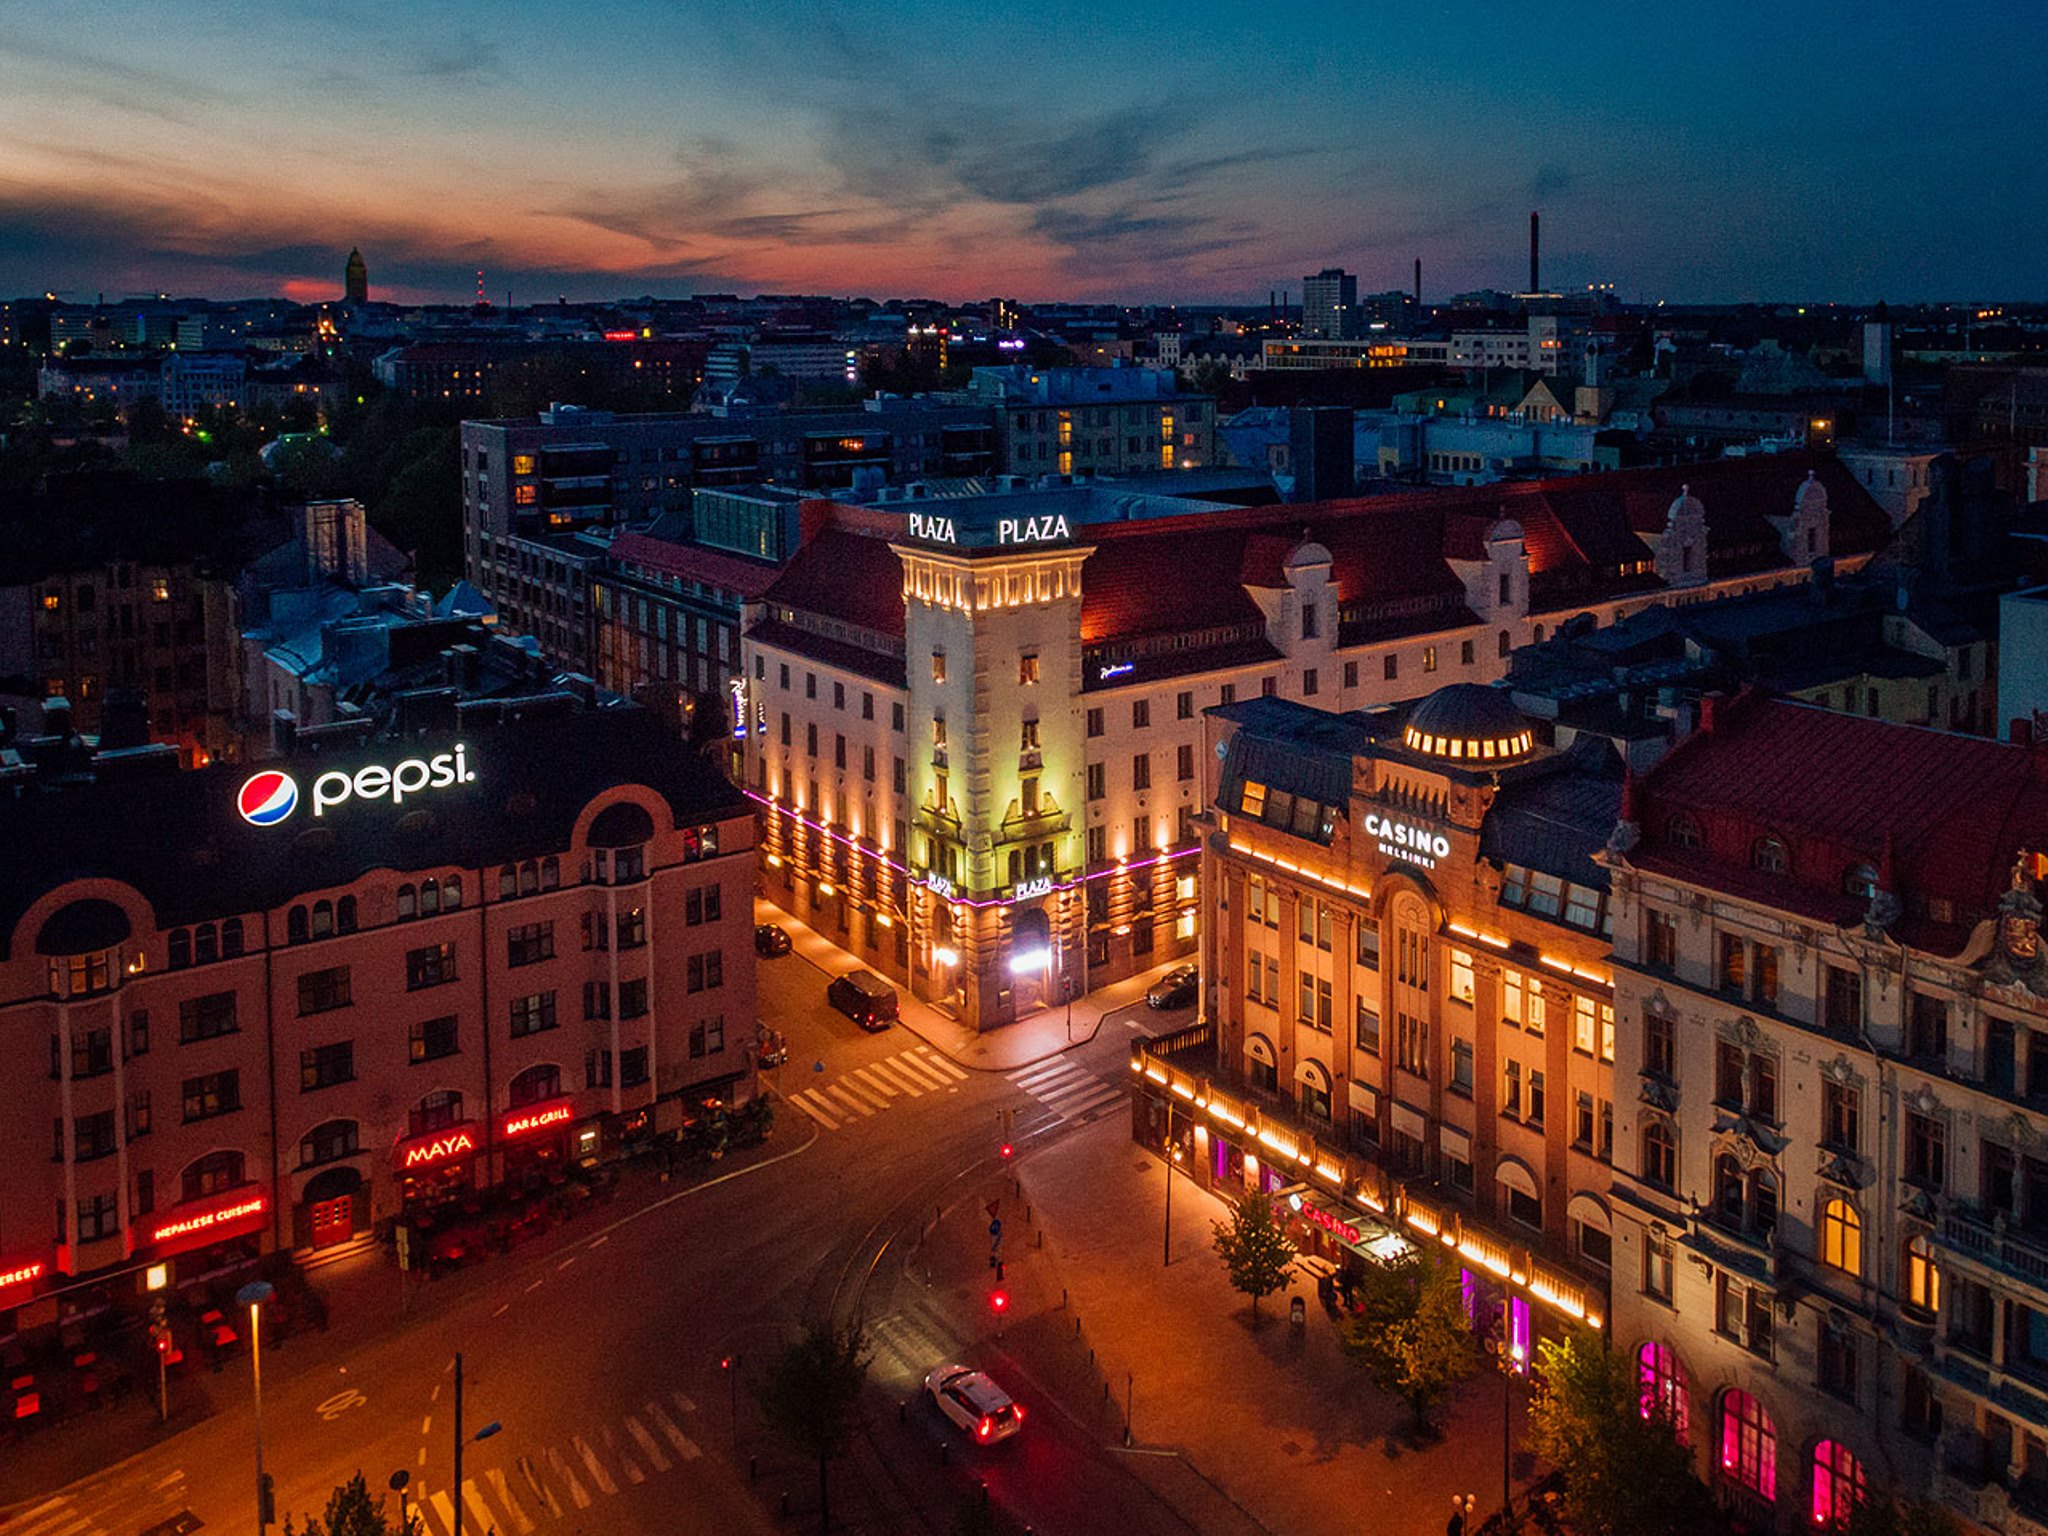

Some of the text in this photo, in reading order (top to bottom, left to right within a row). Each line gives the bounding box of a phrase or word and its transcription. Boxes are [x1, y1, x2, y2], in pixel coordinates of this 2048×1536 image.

[909, 512, 955, 544] PLAZA
[1000, 514, 1069, 544] PLAZA
[1365, 814, 1450, 857] CASINO
[1017, 877, 1051, 901] PLAZA
[507, 1117, 530, 1135] BAR
[540, 1107, 570, 1126] GRILL
[406, 1134, 472, 1167] MAYA
[155, 1199, 262, 1240] NEPALESE CUISINE
[1302, 1200, 1360, 1245] CASINO
